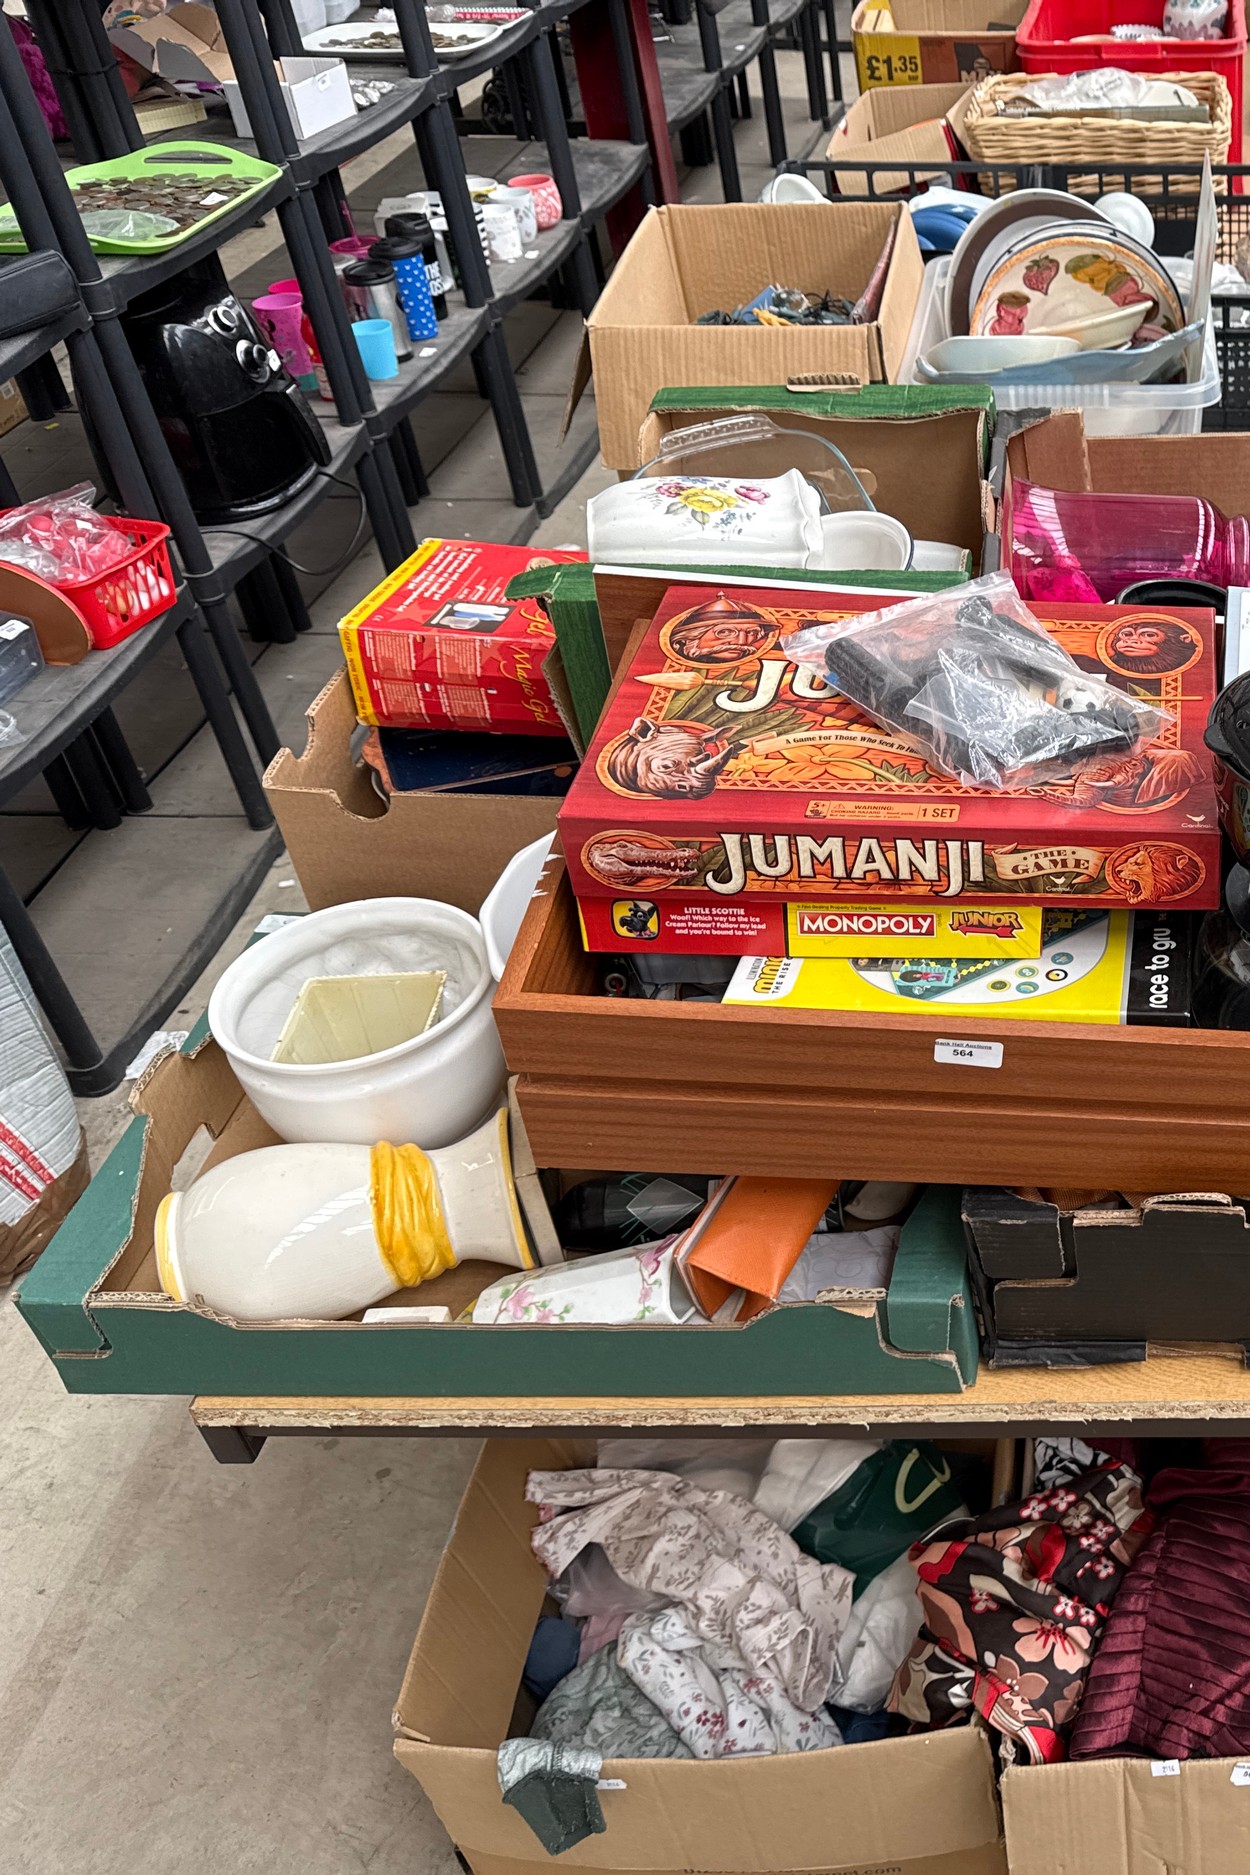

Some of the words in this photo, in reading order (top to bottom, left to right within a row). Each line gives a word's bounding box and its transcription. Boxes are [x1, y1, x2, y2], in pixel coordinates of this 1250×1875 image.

[866, 55, 918, 81] £1.35
[793, 736, 816, 744] Game
[860, 736, 877, 744] Who
[878, 737, 894, 749] Seek
[922, 808, 928, 818] 1
[932, 808, 956, 818] SET
[1030, 850, 1067, 860] THE
[705, 832, 986, 897] JUMANJI
[1011, 858, 1090, 876] GAME
[802, 914, 932, 934] MONOPOLY
[951, 911, 1020, 929] JUNIOR
[1152, 928, 1177, 950] gru
[1144, 954, 1170, 970] to
[771, 982, 784, 994] THE
[778, 962, 792, 979] RISE
[1148, 974, 1170, 1008] race
[952, 1049, 974, 1058] 564
